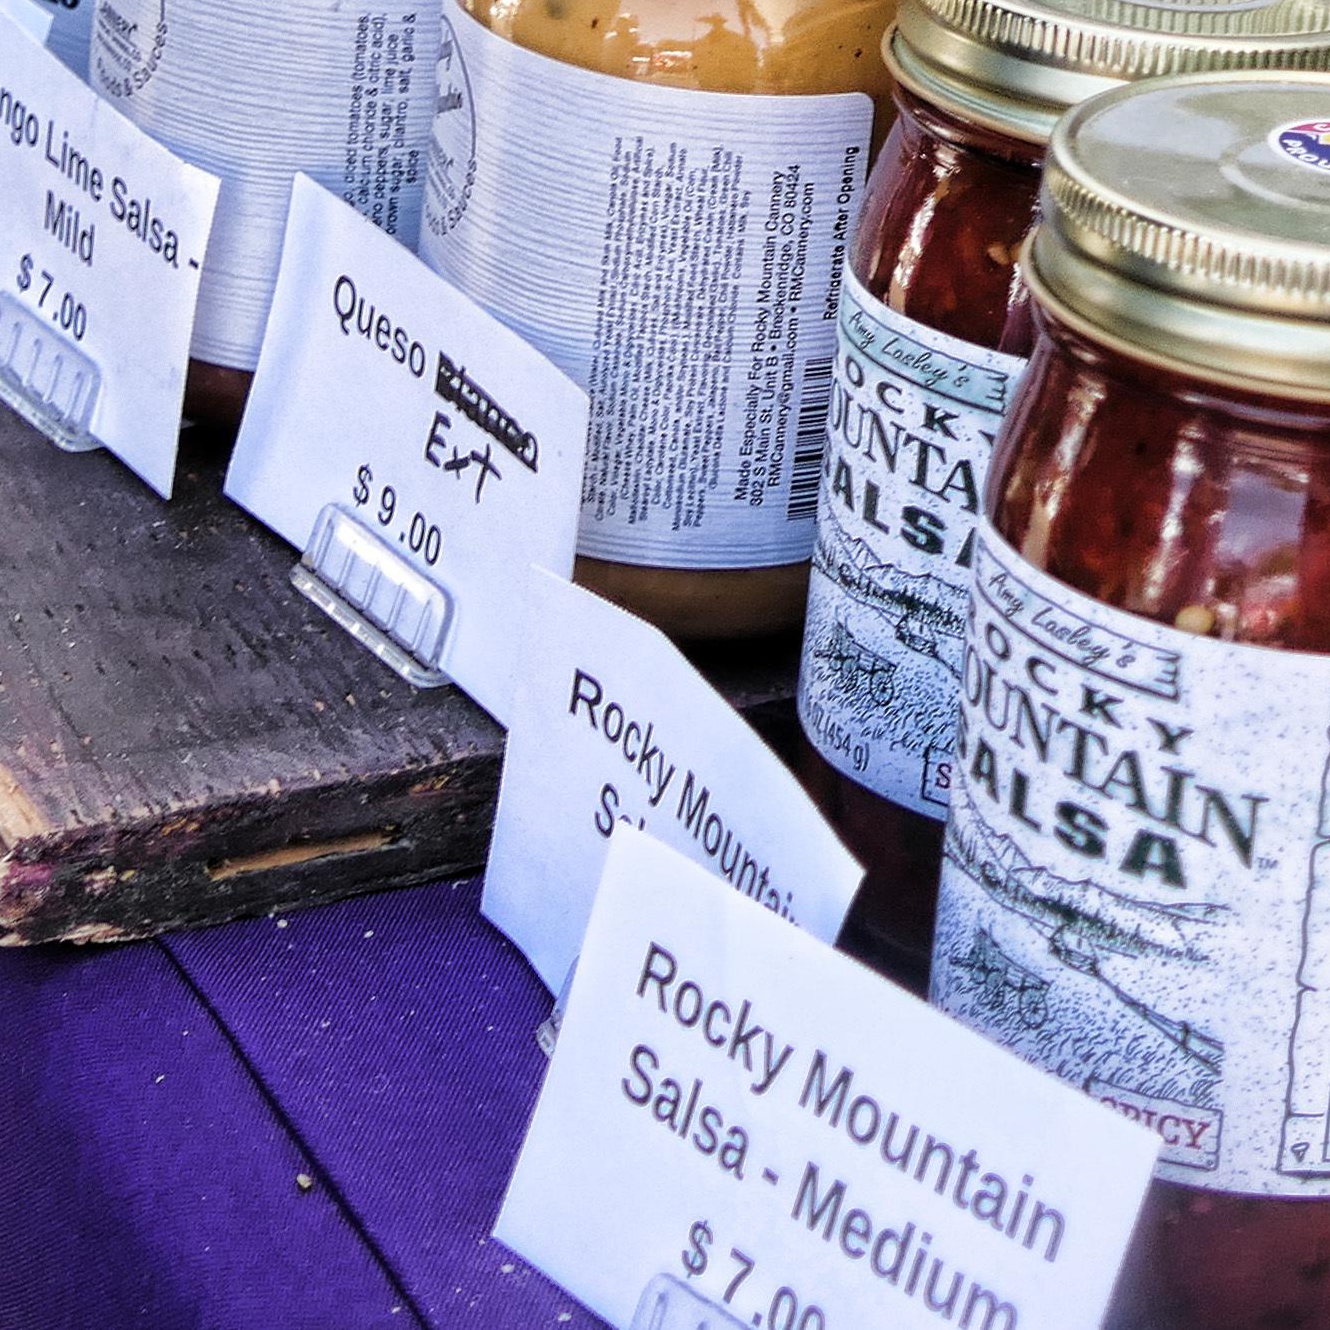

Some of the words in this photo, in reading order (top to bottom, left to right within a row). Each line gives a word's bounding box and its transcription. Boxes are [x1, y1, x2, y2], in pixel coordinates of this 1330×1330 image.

[347, 85, 363, 145] tomatoes
[45, 120, 103, 202] Lime
[110, 176, 179, 269] Salsa
[764, 171, 786, 231] Cannery
[784, 165, 800, 208] 80424
[837, 147, 859, 205] Opening
[44, 190, 95, 267] Mild
[781, 213, 796, 236] CO
[833, 209, 850, 241] After
[757, 236, 777, 303] Mountain
[823, 245, 845, 320] Refrigerate
[334, 275, 425, 378] Queso
[751, 307, 770, 352] Rocky
[767, 318, 799, 487] RMCannery@gmail.com
[788, 183, 814, 301] RMCannery.com
[849, 311, 875, 350] Amy
[748, 357, 762, 380] For
[762, 371, 778, 400] Unit
[766, 356, 779, 367] B
[739, 385, 761, 456] Especially
[759, 405, 774, 423] St.
[845, 355, 996, 446] OCK
[753, 467, 767, 476] S
[754, 429, 770, 461] Main
[829, 378, 978, 515] OUNTA
[734, 461, 750, 500] Made
[749, 481, 765, 507] 302
[830, 456, 978, 568] ALS
[989, 572, 1024, 618] Amy
[975, 615, 1194, 755] OCKY
[964, 644, 1270, 870] OUNTAIN
[569, 668, 675, 807] Rocky
[677, 770, 799, 926] Mountai
[964, 728, 1188, 890] ALSA
[636, 941, 794, 1095] Rocky
[798, 1049, 1066, 1263] Mountain
[621, 1044, 750, 1181] Salsa
[790, 1161, 1018, 1330] Medium
